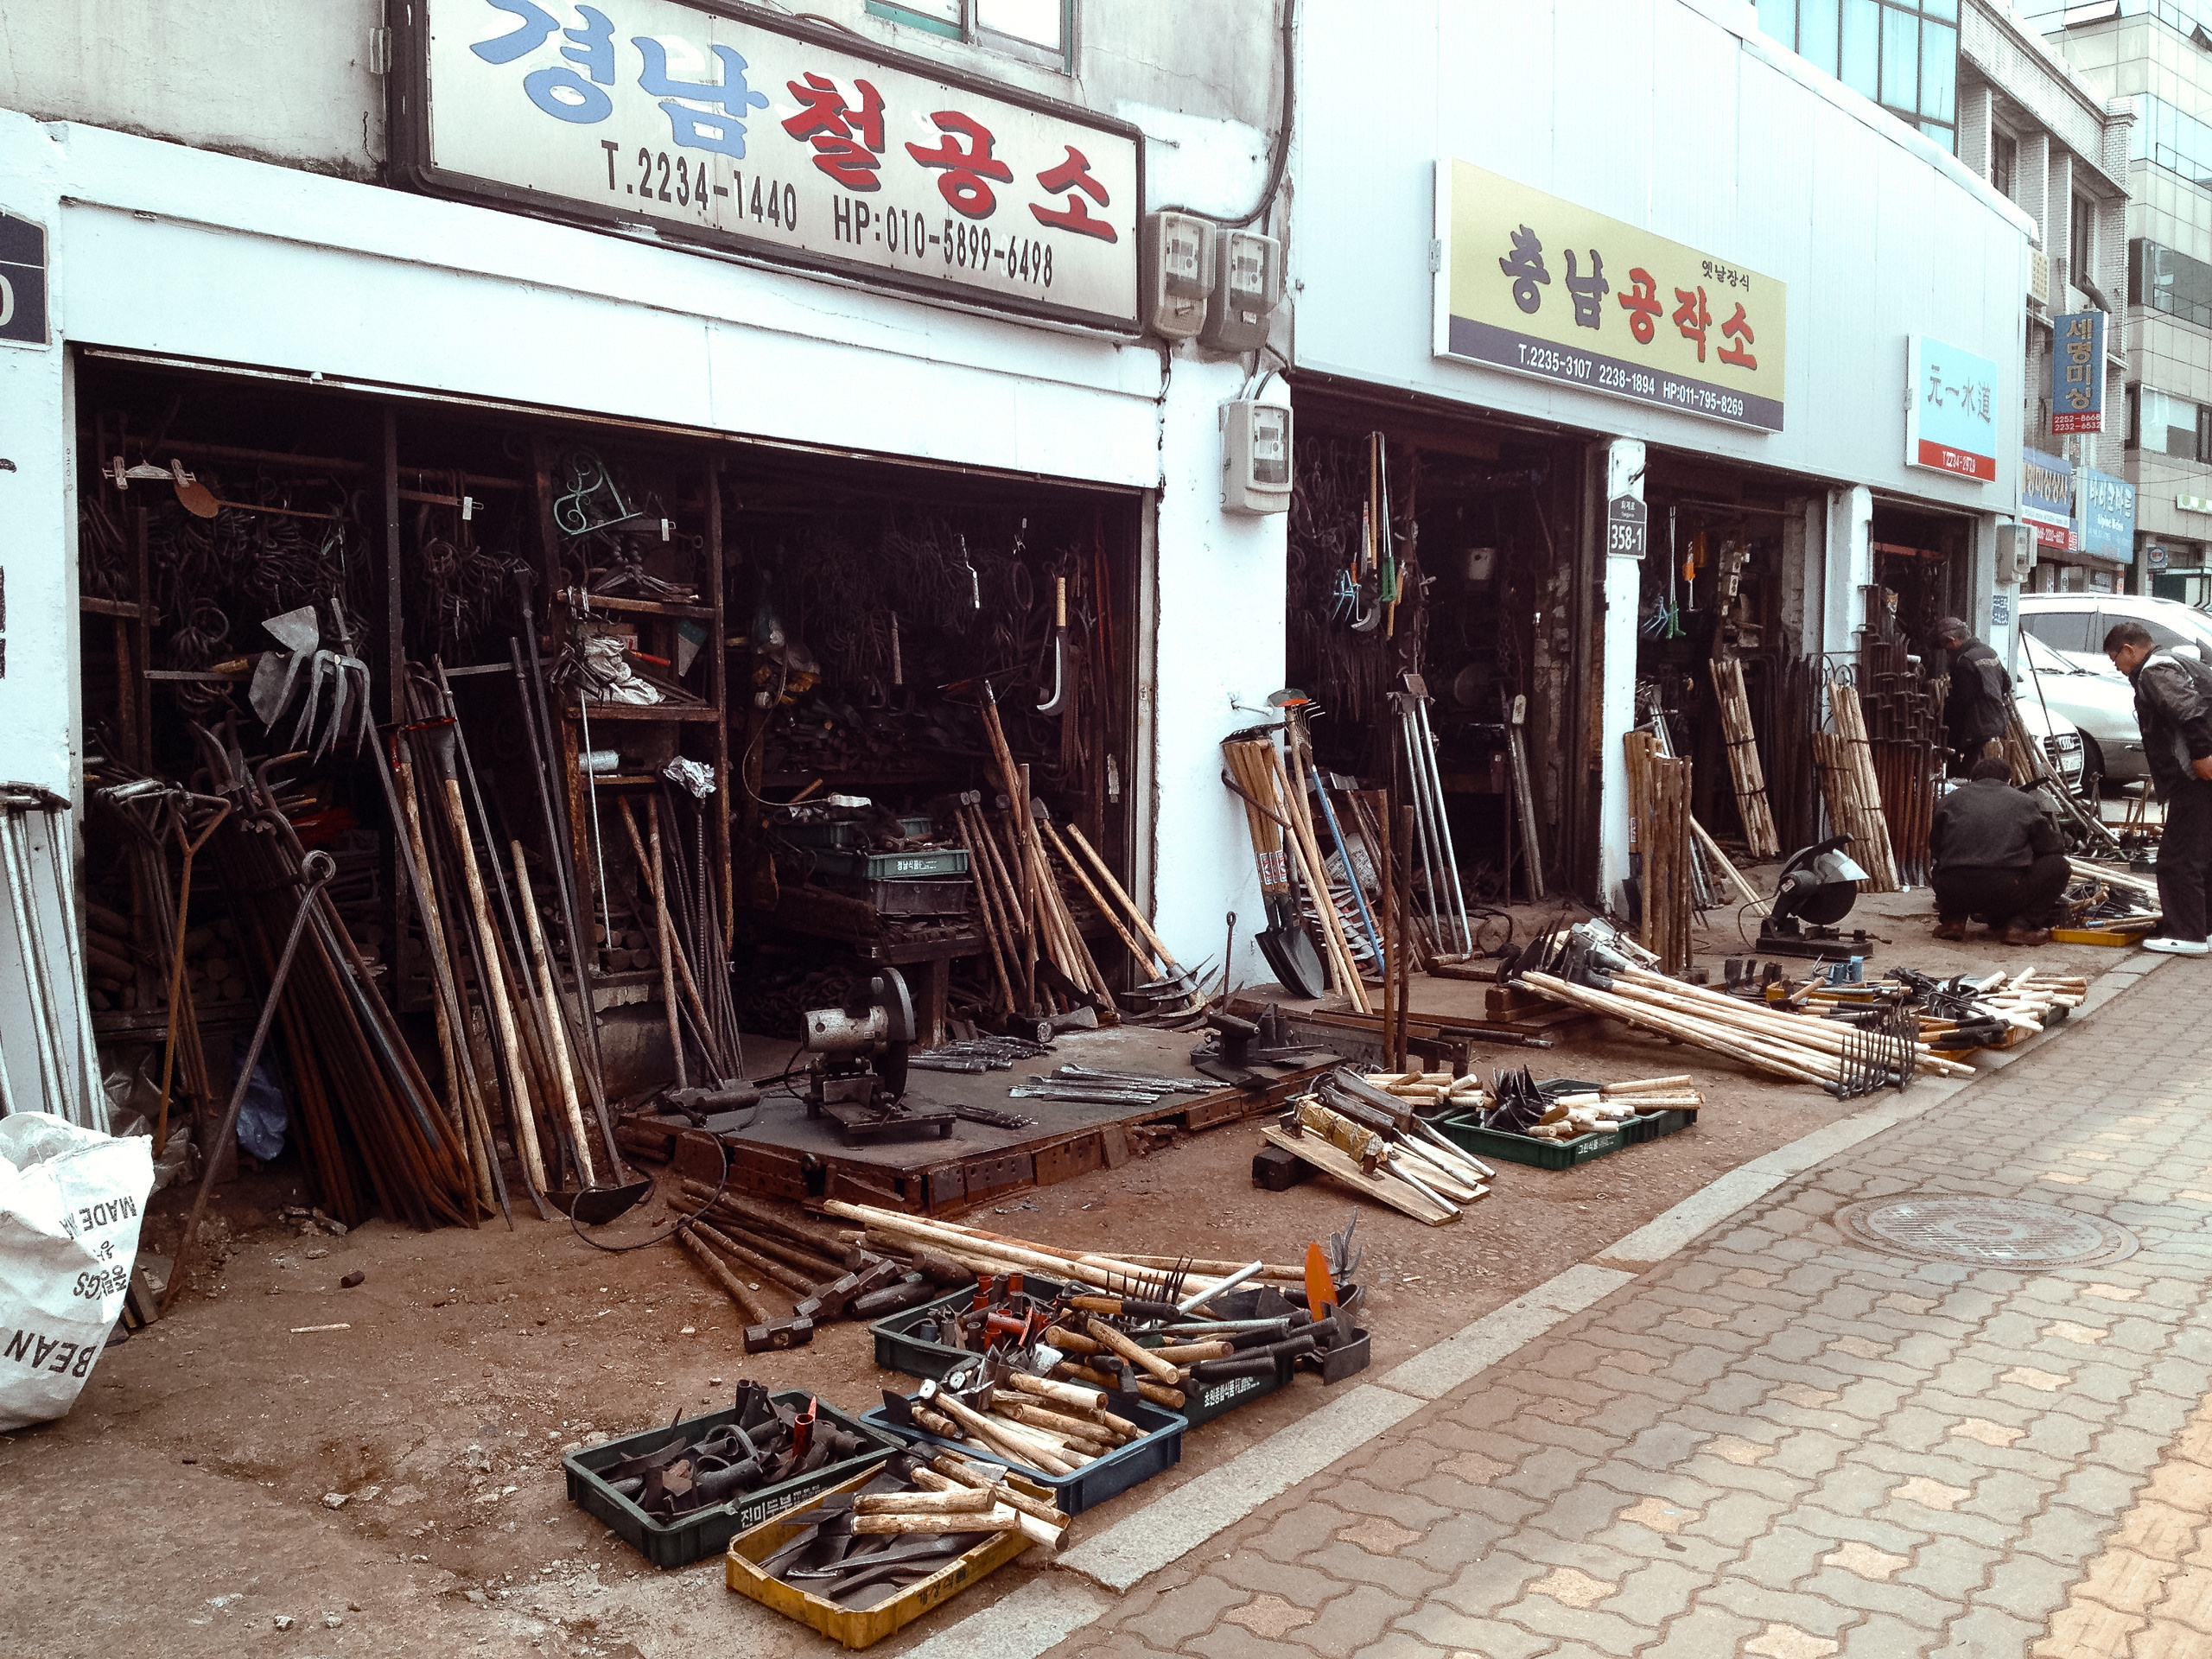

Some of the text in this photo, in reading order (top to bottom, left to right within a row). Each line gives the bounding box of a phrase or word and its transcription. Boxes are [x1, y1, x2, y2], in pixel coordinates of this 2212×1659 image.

[601, 139, 1053, 288] T.2234-1440 HP:010-5899-6498
[1499, 224, 1758, 371] 충남공작소
[1518, 343, 1744, 416] T.2235-3107 2238-1894 HP:011-795-8269
[2065, 318, 2094, 410] 세명미싱
[1927, 364, 1991, 423] 元一水道
[2054, 413, 2101, 423] 2252-8668
[1611, 524, 1643, 551] 358-1
[79, 1195, 137, 1231] MADE
[73, 1272, 101, 1300] GS
[3, 1329, 97, 1378] BEAN
